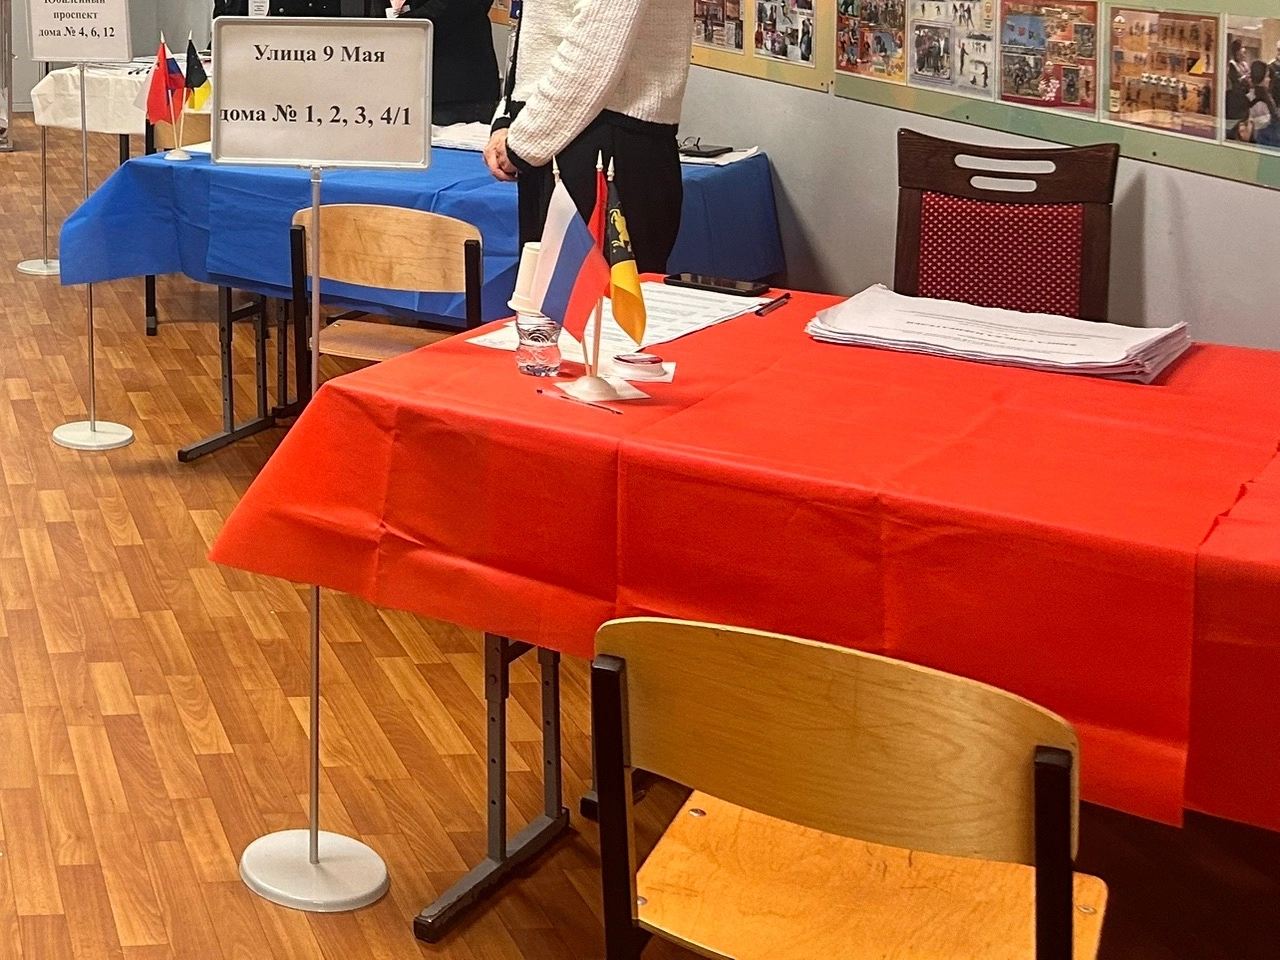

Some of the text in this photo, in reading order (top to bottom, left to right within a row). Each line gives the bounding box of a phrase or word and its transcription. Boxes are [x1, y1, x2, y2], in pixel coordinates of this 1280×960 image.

[53, 12, 98, 21] проспект
[38, 26, 115, 38] дома № 4, 6, 12
[253, 44, 385, 63] Улица 9 Мая
[272, 104, 297, 122] №
[305, 105, 322, 125] 1,
[329, 105, 348, 126] 2,
[355, 106, 373, 127] 3,
[380, 106, 411, 125] 4/1
